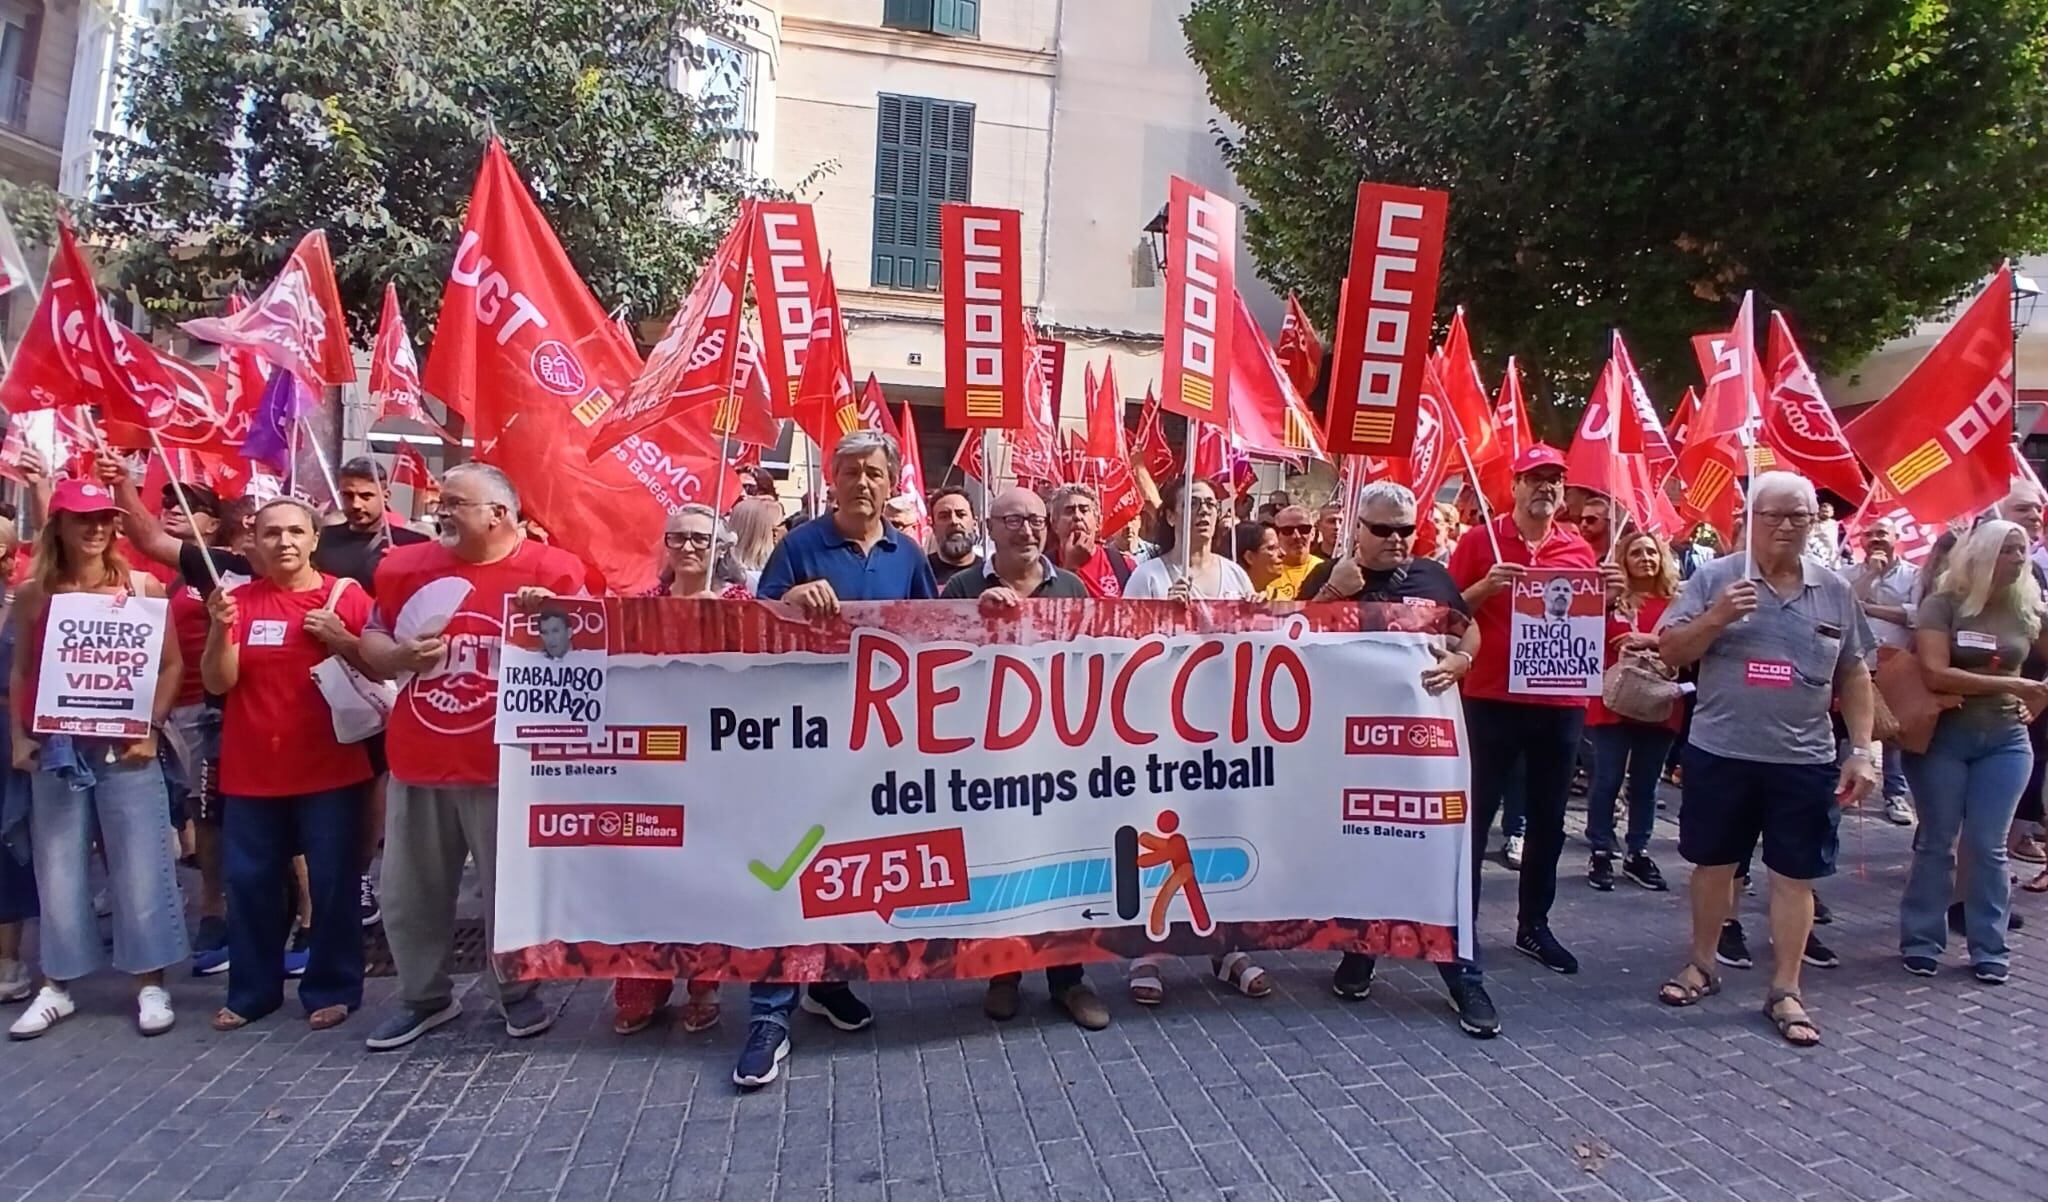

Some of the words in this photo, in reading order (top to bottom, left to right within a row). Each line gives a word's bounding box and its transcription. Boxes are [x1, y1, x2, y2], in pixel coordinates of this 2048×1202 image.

[452, 230, 548, 345] UGT
[1183, 196, 1218, 377] CCOO
[963, 217, 1002, 385] CCOO
[1357, 201, 1423, 407] CCOO
[1515, 578, 1605, 598] ABCAL
[58, 619, 153, 637] QUIERO
[1521, 623, 1571, 639] TENGO
[63, 634, 146, 649] GANAR
[1516, 637, 1587, 659] DERECHO
[57, 648, 149, 666] TIEMPO
[1514, 657, 1600, 676] DESCANSAR
[117, 665, 144, 678] DE
[506, 666, 573, 687] TRABAJA
[572, 667, 603, 691] 80
[1749, 663, 1791, 675] CCOO
[66, 673, 133, 691] VIDA
[710, 707, 780, 751] Per
[792, 705, 828, 748] la
[850, 621, 1311, 754] REDUCCIÓ
[504, 689, 574, 714] COBRA
[571, 698, 601, 722] 20
[1353, 725, 1404, 746] UGT
[531, 764, 561, 776] Illes
[565, 764, 617, 776] Balears
[871, 769, 936, 815] del
[948, 765, 1077, 816] temps
[1089, 756, 1135, 797] de
[1146, 746, 1274, 793] treball
[1349, 794, 1443, 819] CCOO
[539, 814, 595, 837] UGT
[636, 813, 658, 824] Illes
[636, 825, 677, 837] Balears
[1343, 825, 1370, 835] Illes
[1374, 826, 1425, 839] Balears
[815, 849, 910, 904] 37,5
[916, 845, 954, 889] h
